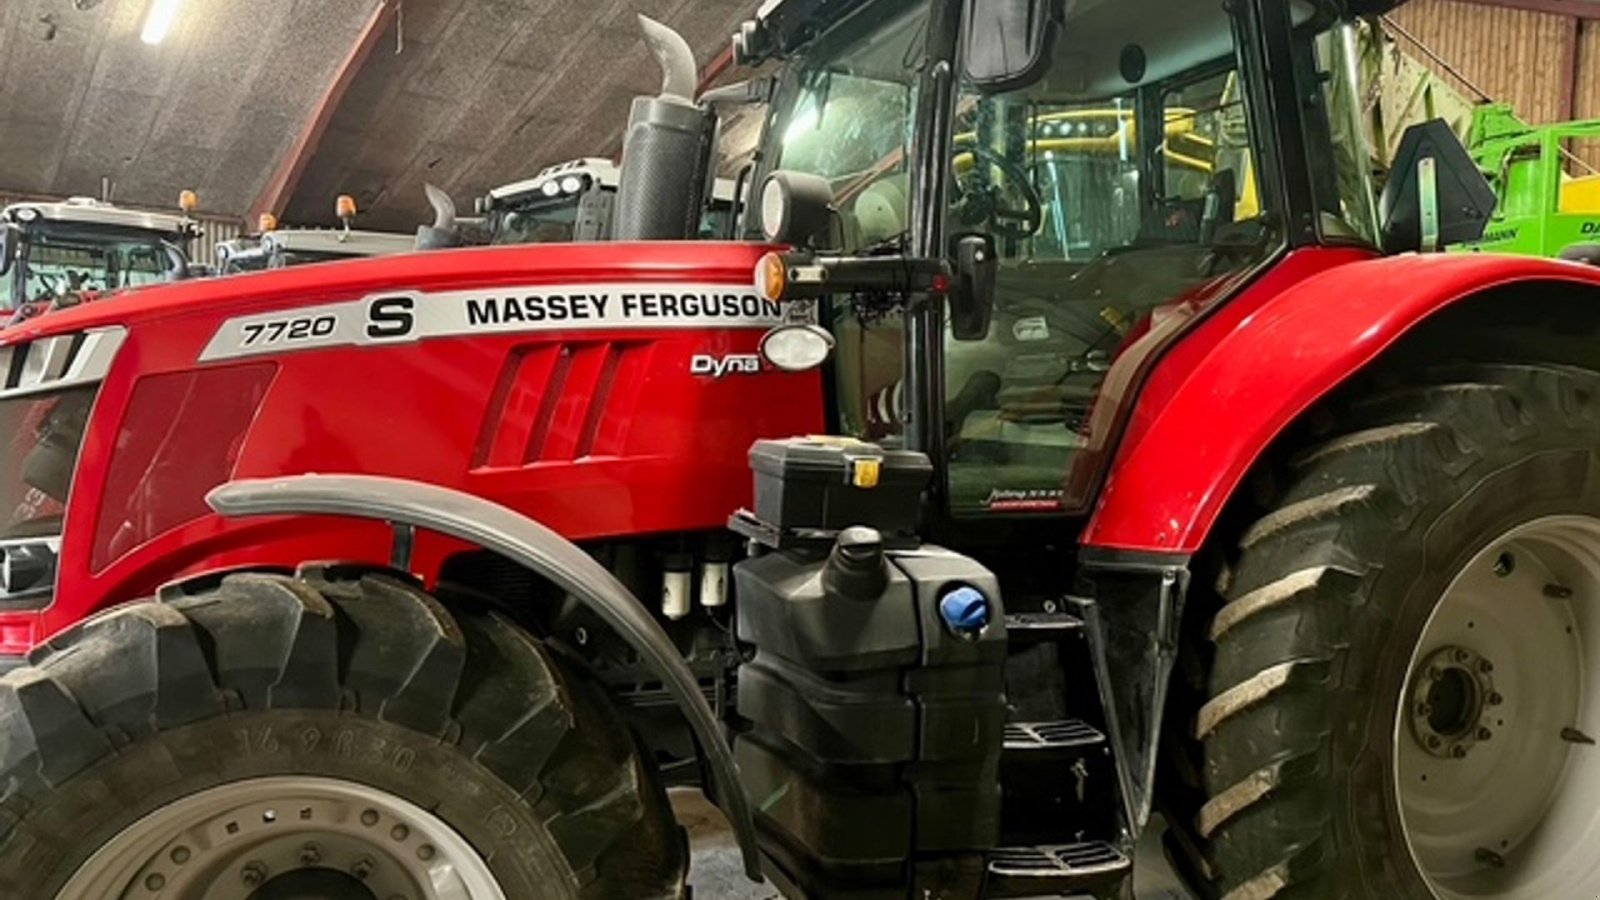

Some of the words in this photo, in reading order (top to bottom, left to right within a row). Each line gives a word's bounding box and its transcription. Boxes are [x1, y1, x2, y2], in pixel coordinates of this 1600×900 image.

[244, 317, 335, 344] 7720
[367, 297, 413, 338] S
[467, 294, 610, 325] MASSEY
[622, 294, 782, 318] FERGUSON
